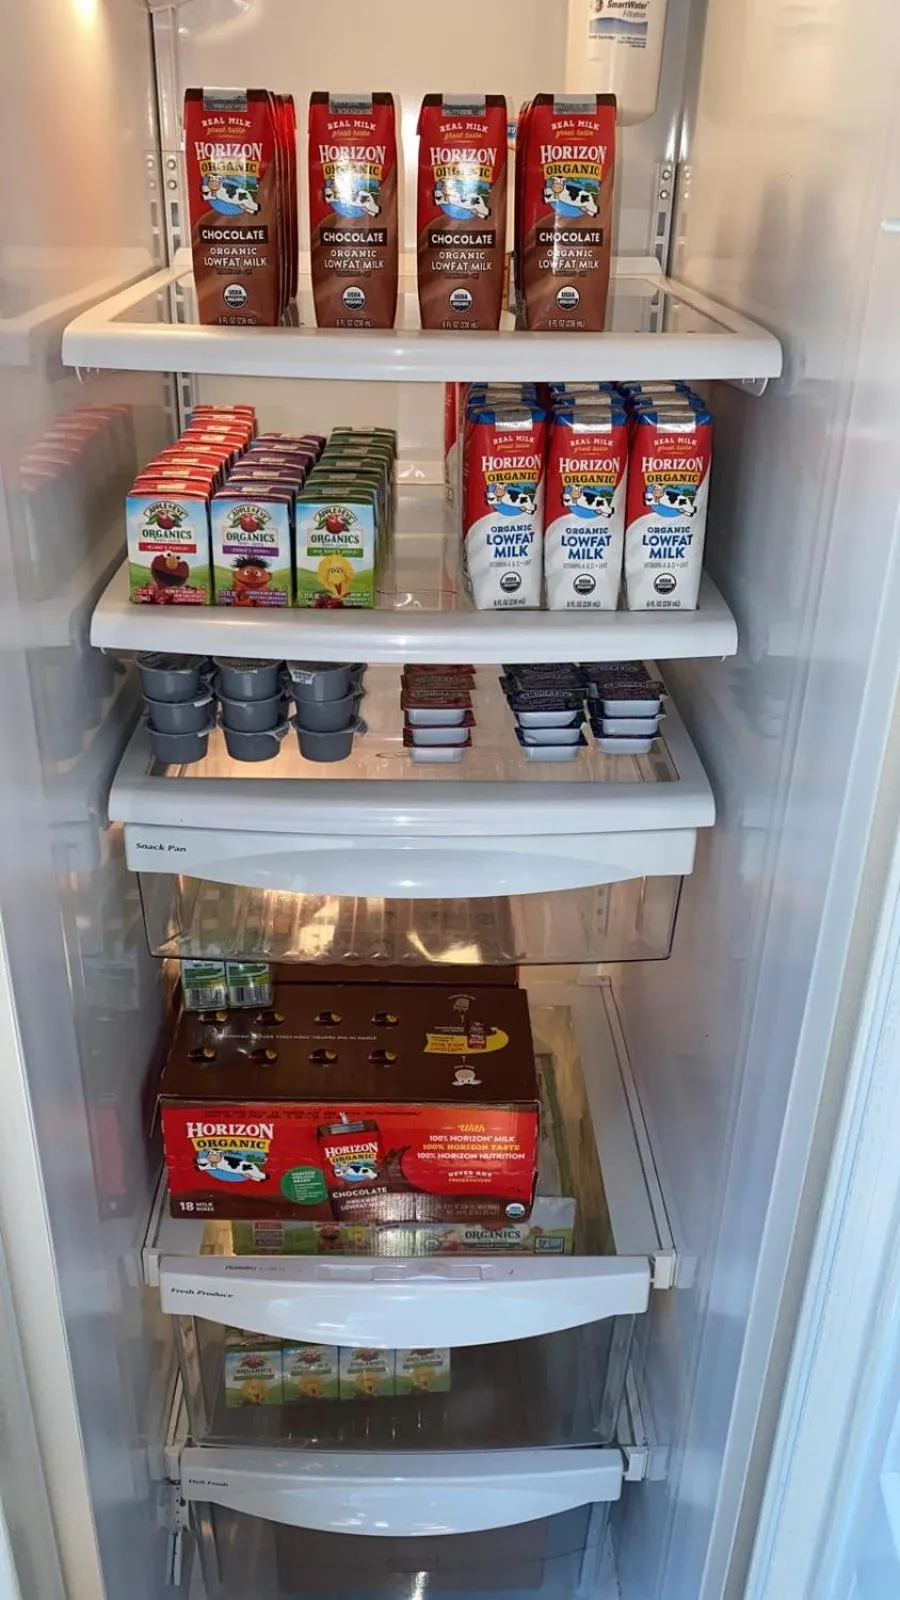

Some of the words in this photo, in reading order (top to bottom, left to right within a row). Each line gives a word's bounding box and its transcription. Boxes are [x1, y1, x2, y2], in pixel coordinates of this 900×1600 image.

[607, 0, 648, 10] SmartWater
[201, 117, 226, 128] REAL
[228, 117, 252, 128] MILK
[327, 120, 351, 131] REAL
[353, 120, 376, 131] MILK
[440, 121, 463, 132] REAL
[466, 122, 489, 133] MILK
[551, 120, 575, 130] REAL
[577, 120, 600, 131] MILK
[194, 142, 263, 161] HORIZON
[318, 145, 386, 164] HORIZON
[430, 147, 497, 165] HORIZON
[540, 146, 607, 164] HORIZON
[201, 162, 257, 173] ORGANIC
[546, 163, 600, 177] ORGANIC
[202, 229, 265, 240] CHOCOLATE
[323, 232, 384, 242] CHOCOLATE
[431, 234, 492, 244] CHOCOLATE
[539, 232, 600, 242] CHOCOLATE
[203, 256, 240, 266] LOWFAT
[243, 257, 268, 266] MILK
[324, 260, 360, 269] LOWFAT
[363, 260, 384, 269] MILK
[431, 261, 468, 271] LOWFAT
[471, 261, 493, 271] MILK
[539, 259, 576, 268] LOWFAT
[579, 260, 599, 268] MILK
[493, 437, 514, 445] REAL
[516, 435, 535, 444] MILK
[594, 438, 613, 446] MILK
[654, 438, 674, 446] REAL
[677, 438, 697, 446] MILK
[481, 454, 542, 471] HORIZON
[559, 457, 620, 473] HORIZON
[641, 456, 703, 472] HORIZON
[487, 472, 537, 482] ORGANIC
[564, 474, 615, 484] ORGANIC
[646, 473, 697, 483] ORGANIC
[490, 524, 532, 533] ORGANIC
[565, 527, 609, 535] ORGANIC
[647, 526, 691, 534] ORGANIC
[142, 529, 192, 540] ORGANICS
[226, 532, 275, 543] ORGANICS
[311, 534, 360, 544] ORGANICS
[486, 532, 535, 545] LOWFAT
[642, 534, 693, 546] LOWFAT
[561, 535, 612, 547] LOWFAT
[494, 545, 528, 558] MILK
[568, 548, 604, 560] MILK
[649, 547, 685, 559] MILK
[136, 841, 165, 851] Snack
[167, 843, 187, 852] Pan
[186, 1122, 274, 1139] HORIZON
[458, 1124, 486, 1133] With
[197, 1139, 265, 1150] ORGANIC
[324, 1142, 379, 1158] HORIZON
[331, 1153, 374, 1164] ORGANIC
[332, 1187, 388, 1198] CHOCOLATE
[179, 1201, 194, 1211] 18
[464, 1229, 521, 1240] ORGANICS
[171, 1287, 194, 1295] Fresh
[197, 1290, 234, 1298] Produce
